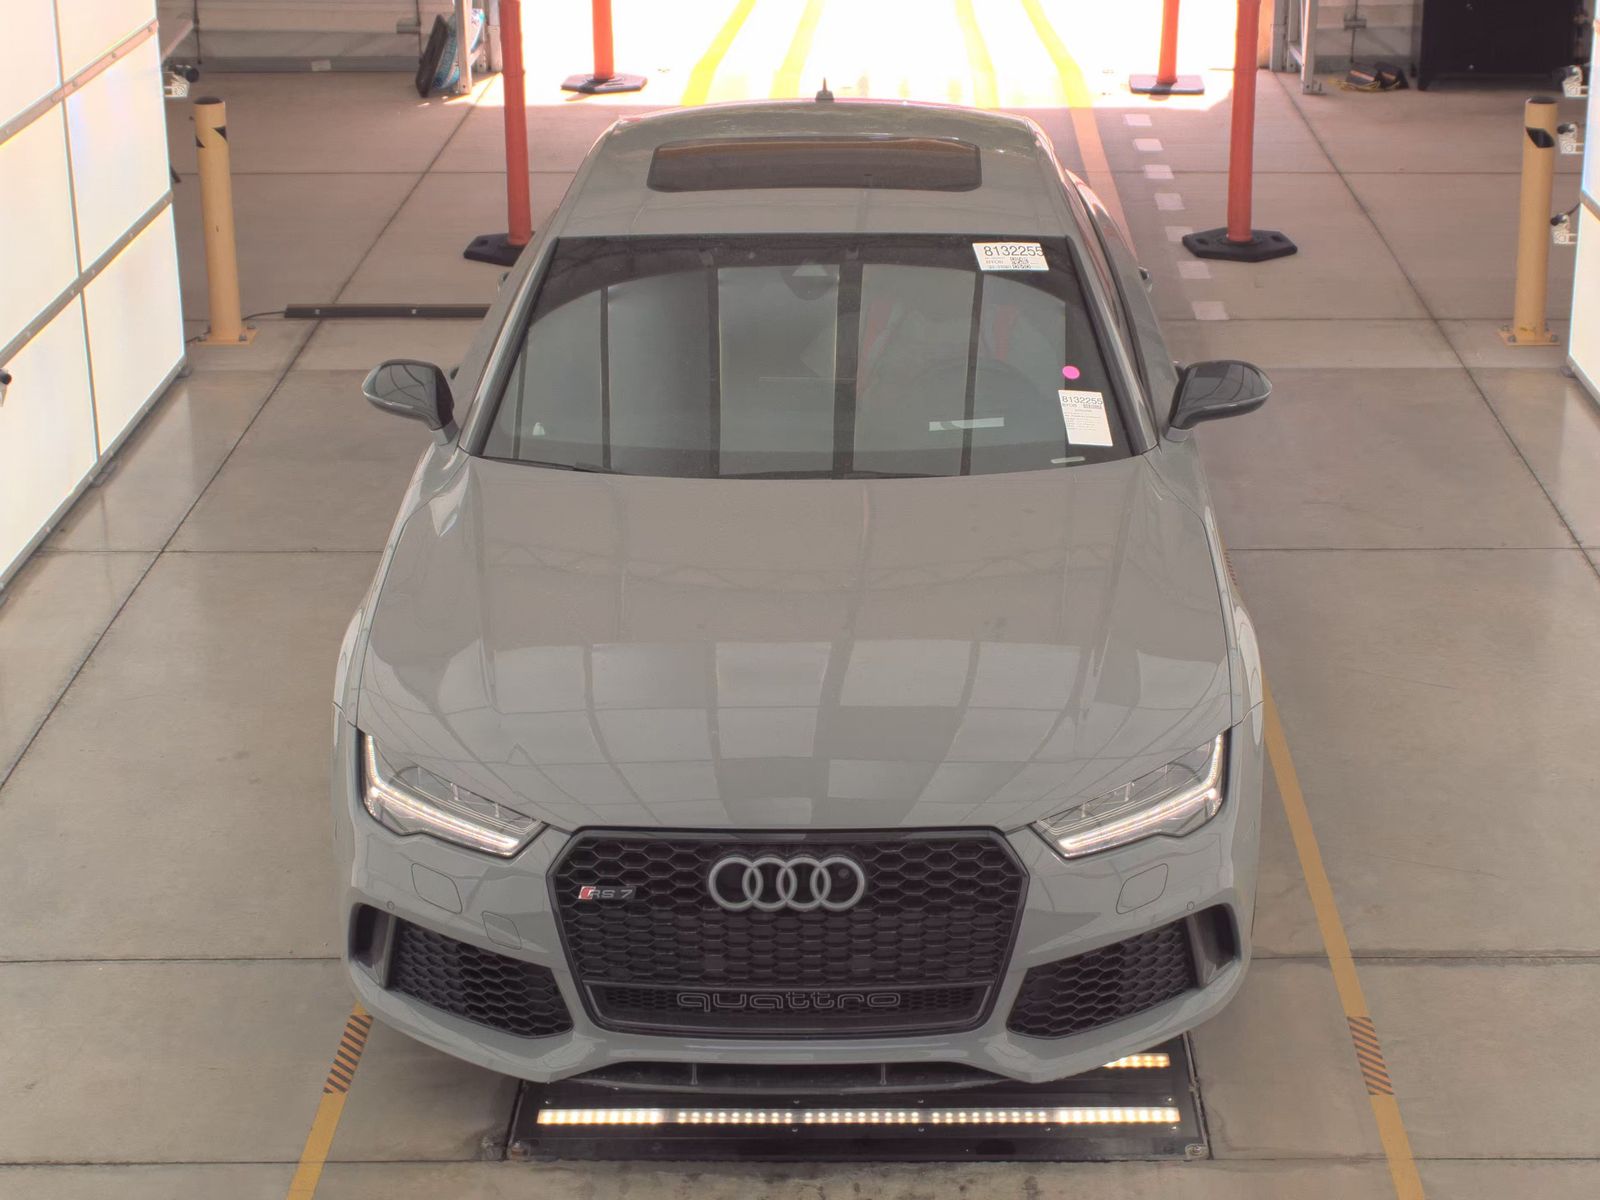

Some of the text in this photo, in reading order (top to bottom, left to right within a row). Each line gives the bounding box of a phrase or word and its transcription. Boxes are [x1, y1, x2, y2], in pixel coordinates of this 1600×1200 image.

[983, 245, 1044, 257] 8132255
[1062, 396, 1103, 405] 8132255
[676, 991, 902, 1013] quattro
